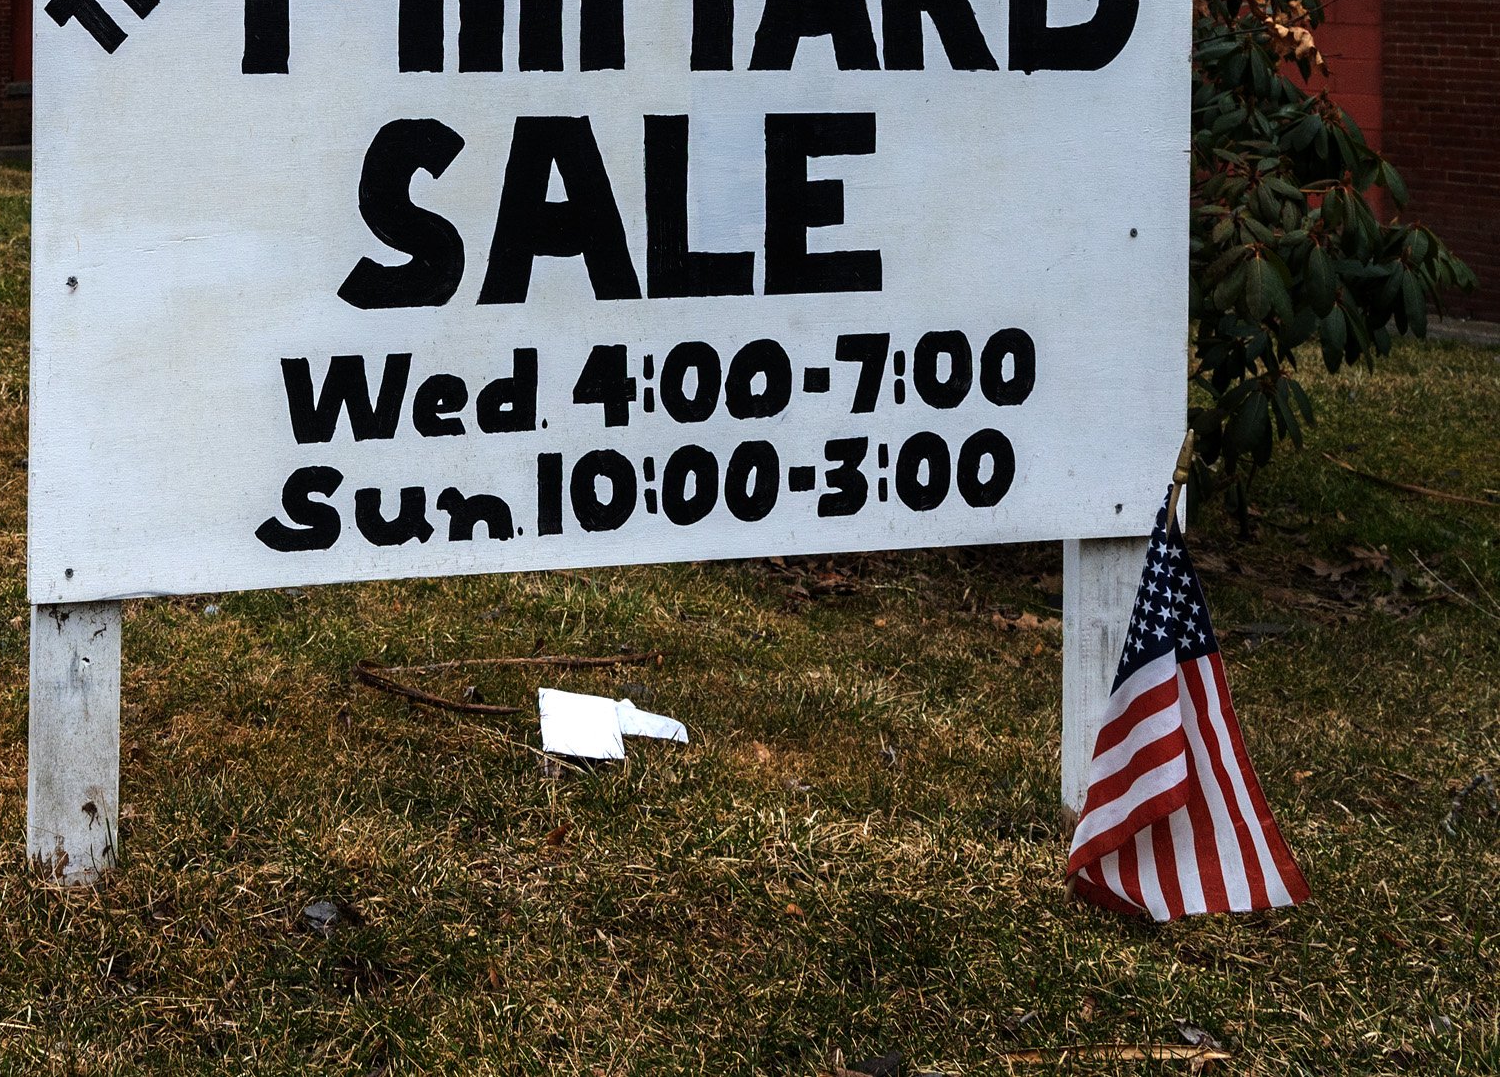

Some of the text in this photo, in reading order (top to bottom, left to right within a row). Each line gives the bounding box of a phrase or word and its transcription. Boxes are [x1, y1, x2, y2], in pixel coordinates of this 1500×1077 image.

[337, 112, 882, 309] SALE
[281, 328, 1035, 444] Wed. 4:00-7:00
[255, 428, 1015, 552] Sun. 10:00-3:00
